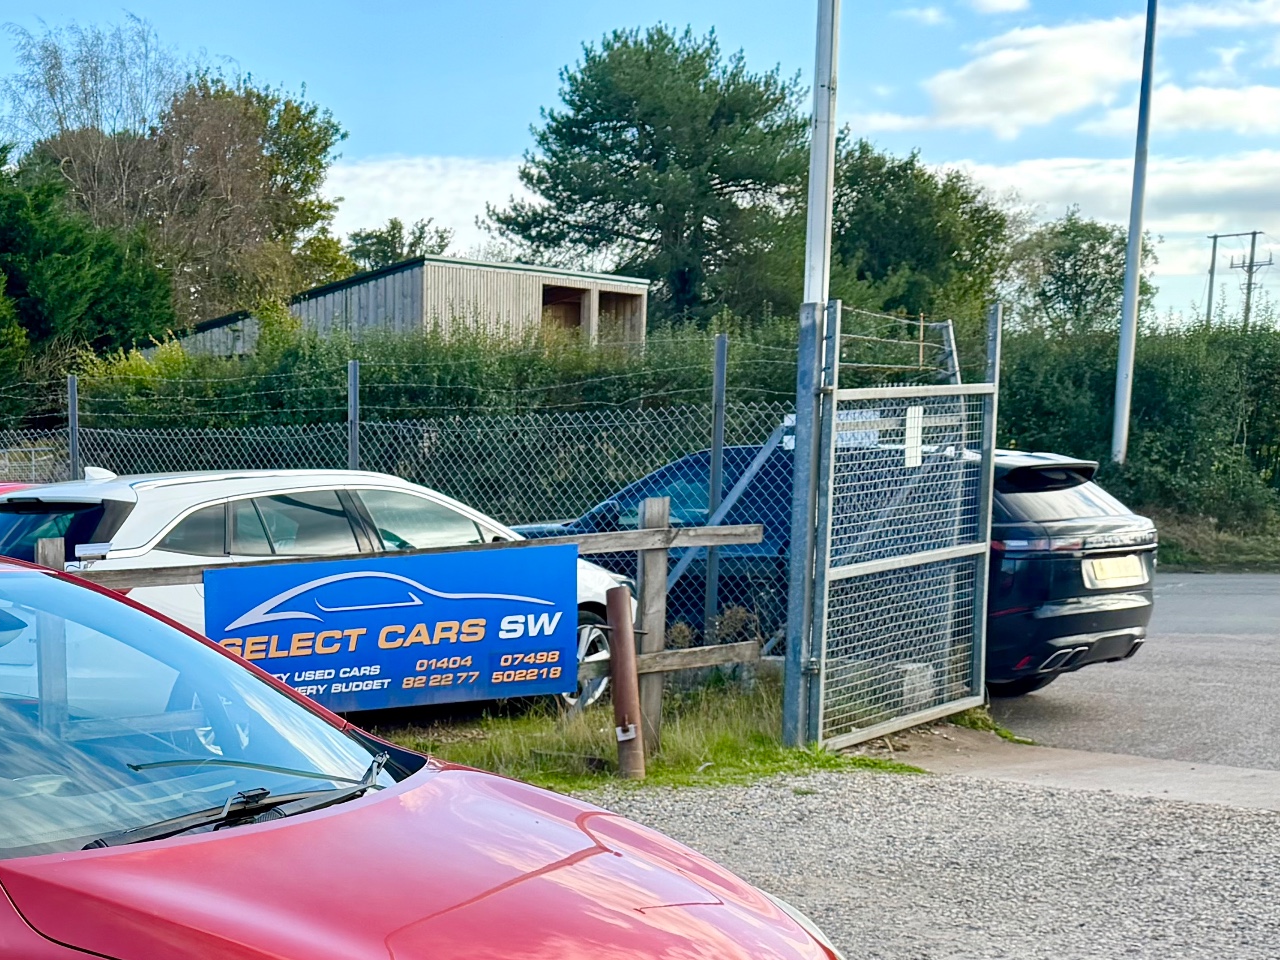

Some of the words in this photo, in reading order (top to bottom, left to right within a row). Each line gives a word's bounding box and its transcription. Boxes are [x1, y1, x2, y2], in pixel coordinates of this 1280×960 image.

[219, 628, 367, 660] SELECT
[378, 618, 486, 650] CARS
[498, 611, 563, 639] SW
[415, 656, 473, 671] 01404
[500, 651, 560, 666] 07498
[294, 669, 335, 681] USED
[339, 665, 381, 678] CARS
[491, 667, 562, 683] 502218
[331, 679, 391, 693] BUDGET
